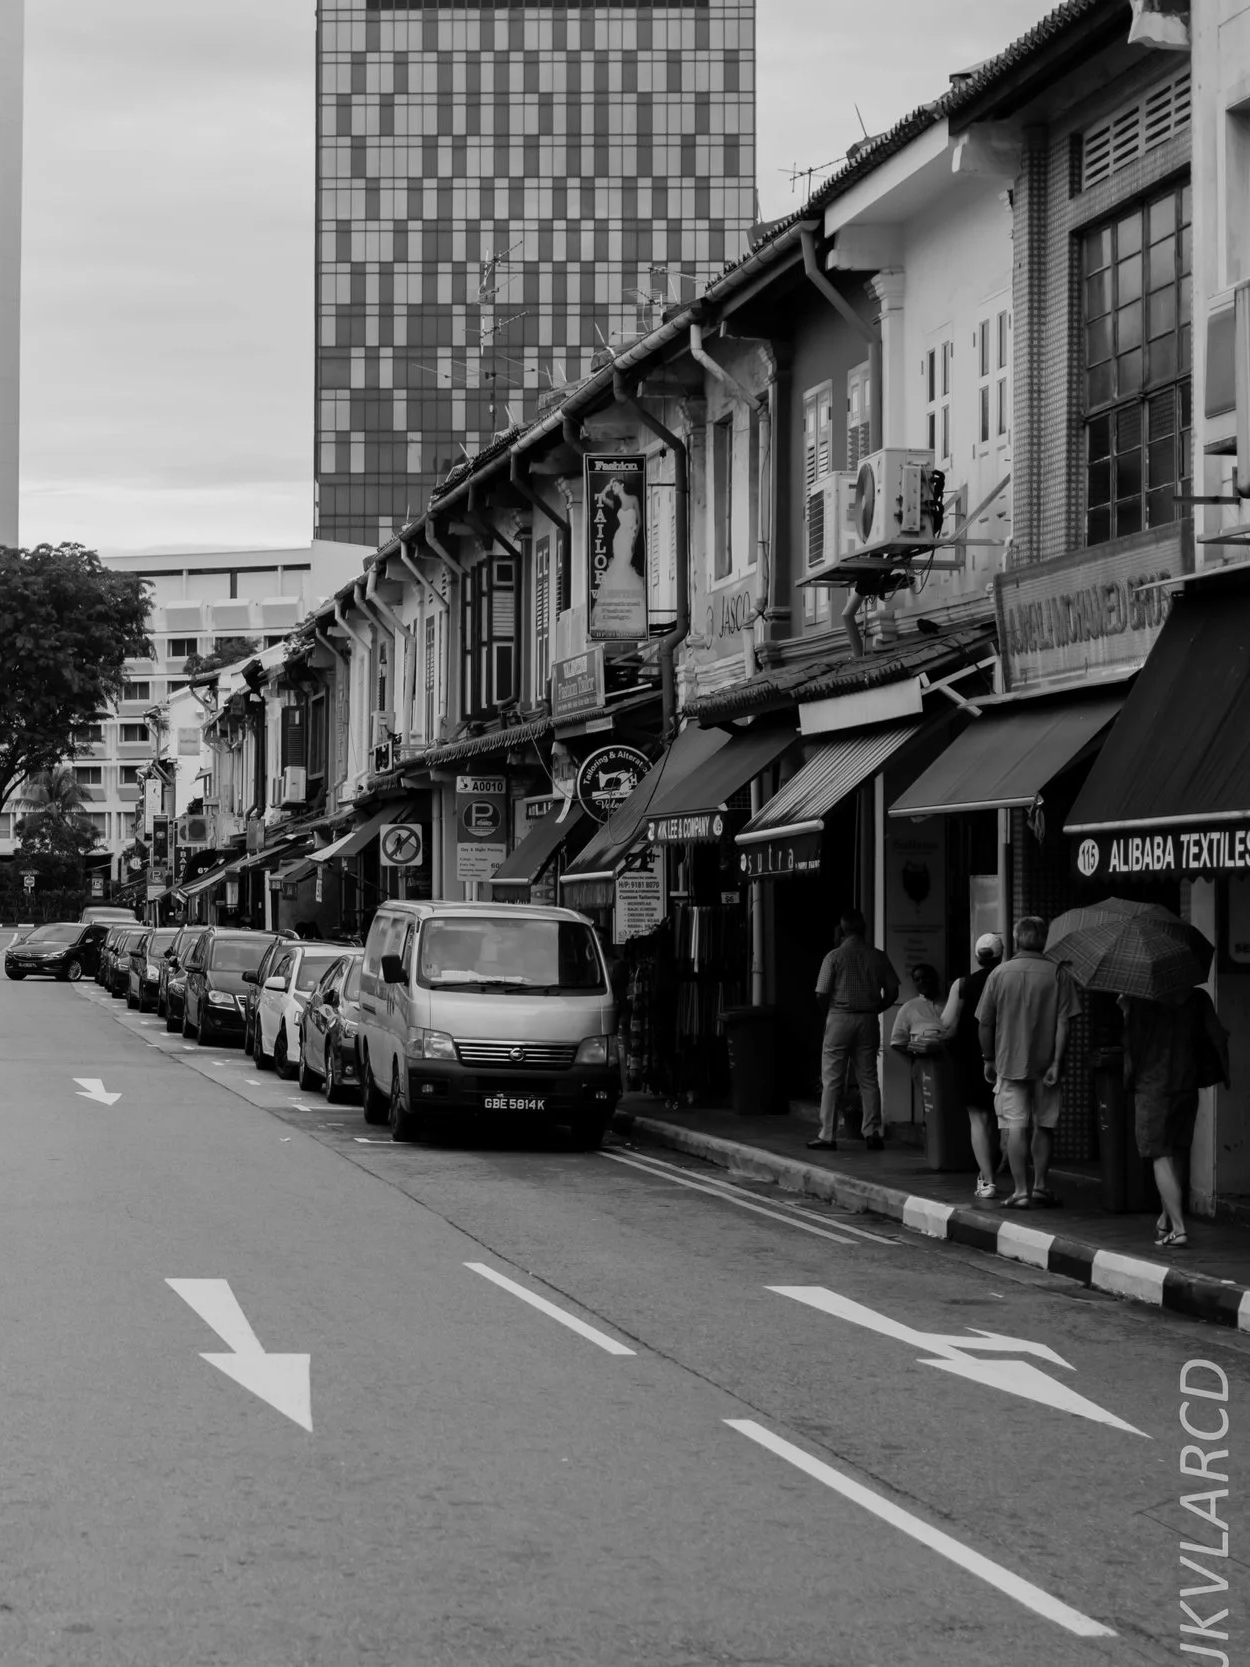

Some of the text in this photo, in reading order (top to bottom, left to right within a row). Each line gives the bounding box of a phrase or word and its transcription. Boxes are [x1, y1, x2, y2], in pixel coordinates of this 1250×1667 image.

[594, 461, 638, 471] Fashion
[594, 493, 608, 584] TAILOR
[719, 592, 750, 637] JASCO
[583, 755, 609, 785] Tailoring
[609, 751, 616, 759] &
[472, 782, 503, 792] A0010
[683, 816, 710, 838] COMPANY
[748, 844, 793, 874] sutra
[1081, 844, 1096, 871] 115
[1109, 835, 1175, 872] ALIBABA
